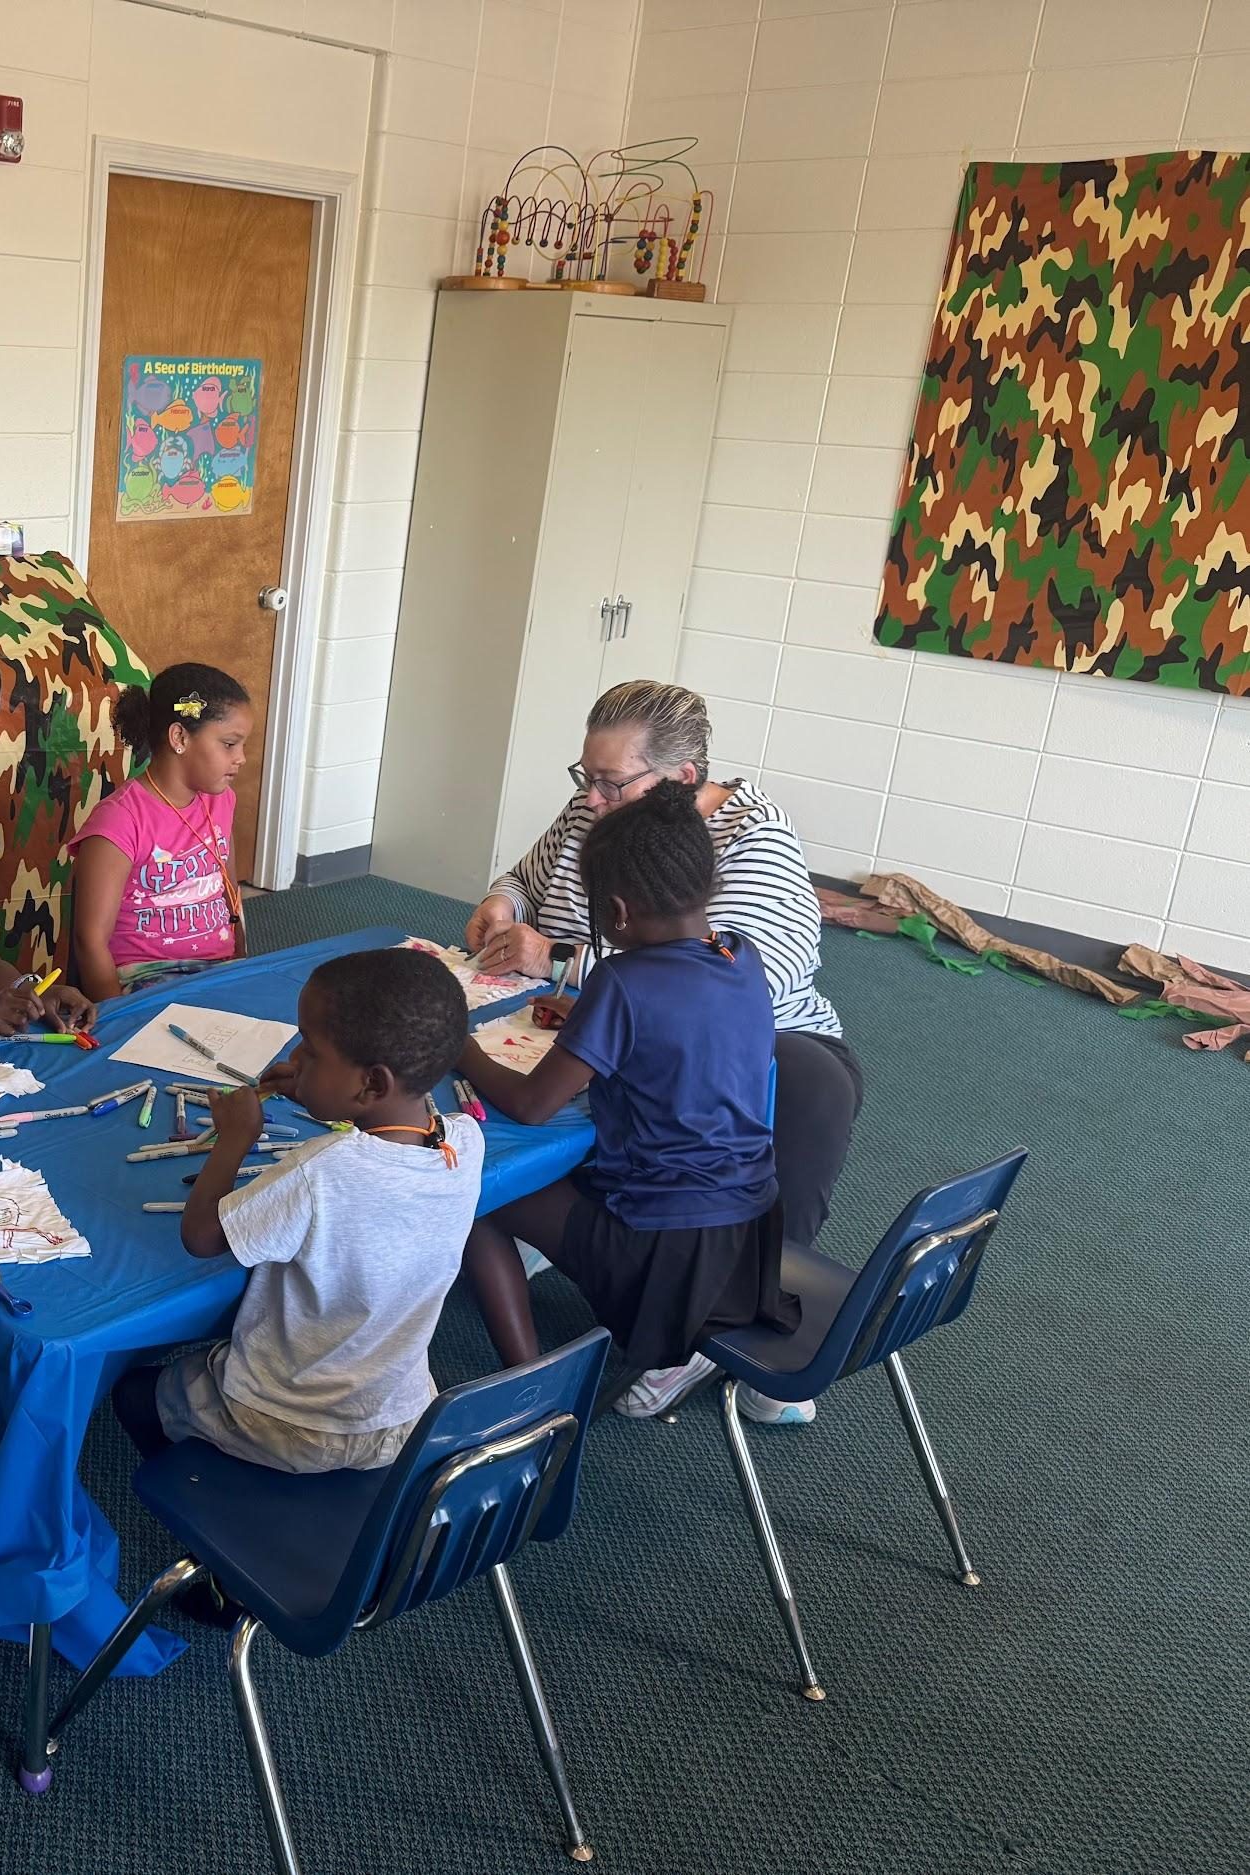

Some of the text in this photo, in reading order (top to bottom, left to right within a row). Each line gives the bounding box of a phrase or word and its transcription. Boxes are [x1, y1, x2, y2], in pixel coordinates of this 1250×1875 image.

[7, 100, 21, 108] FIRE
[143, 361, 244, 376] A Sea of Birthdays
[133, 897, 230, 933] FUTUR
